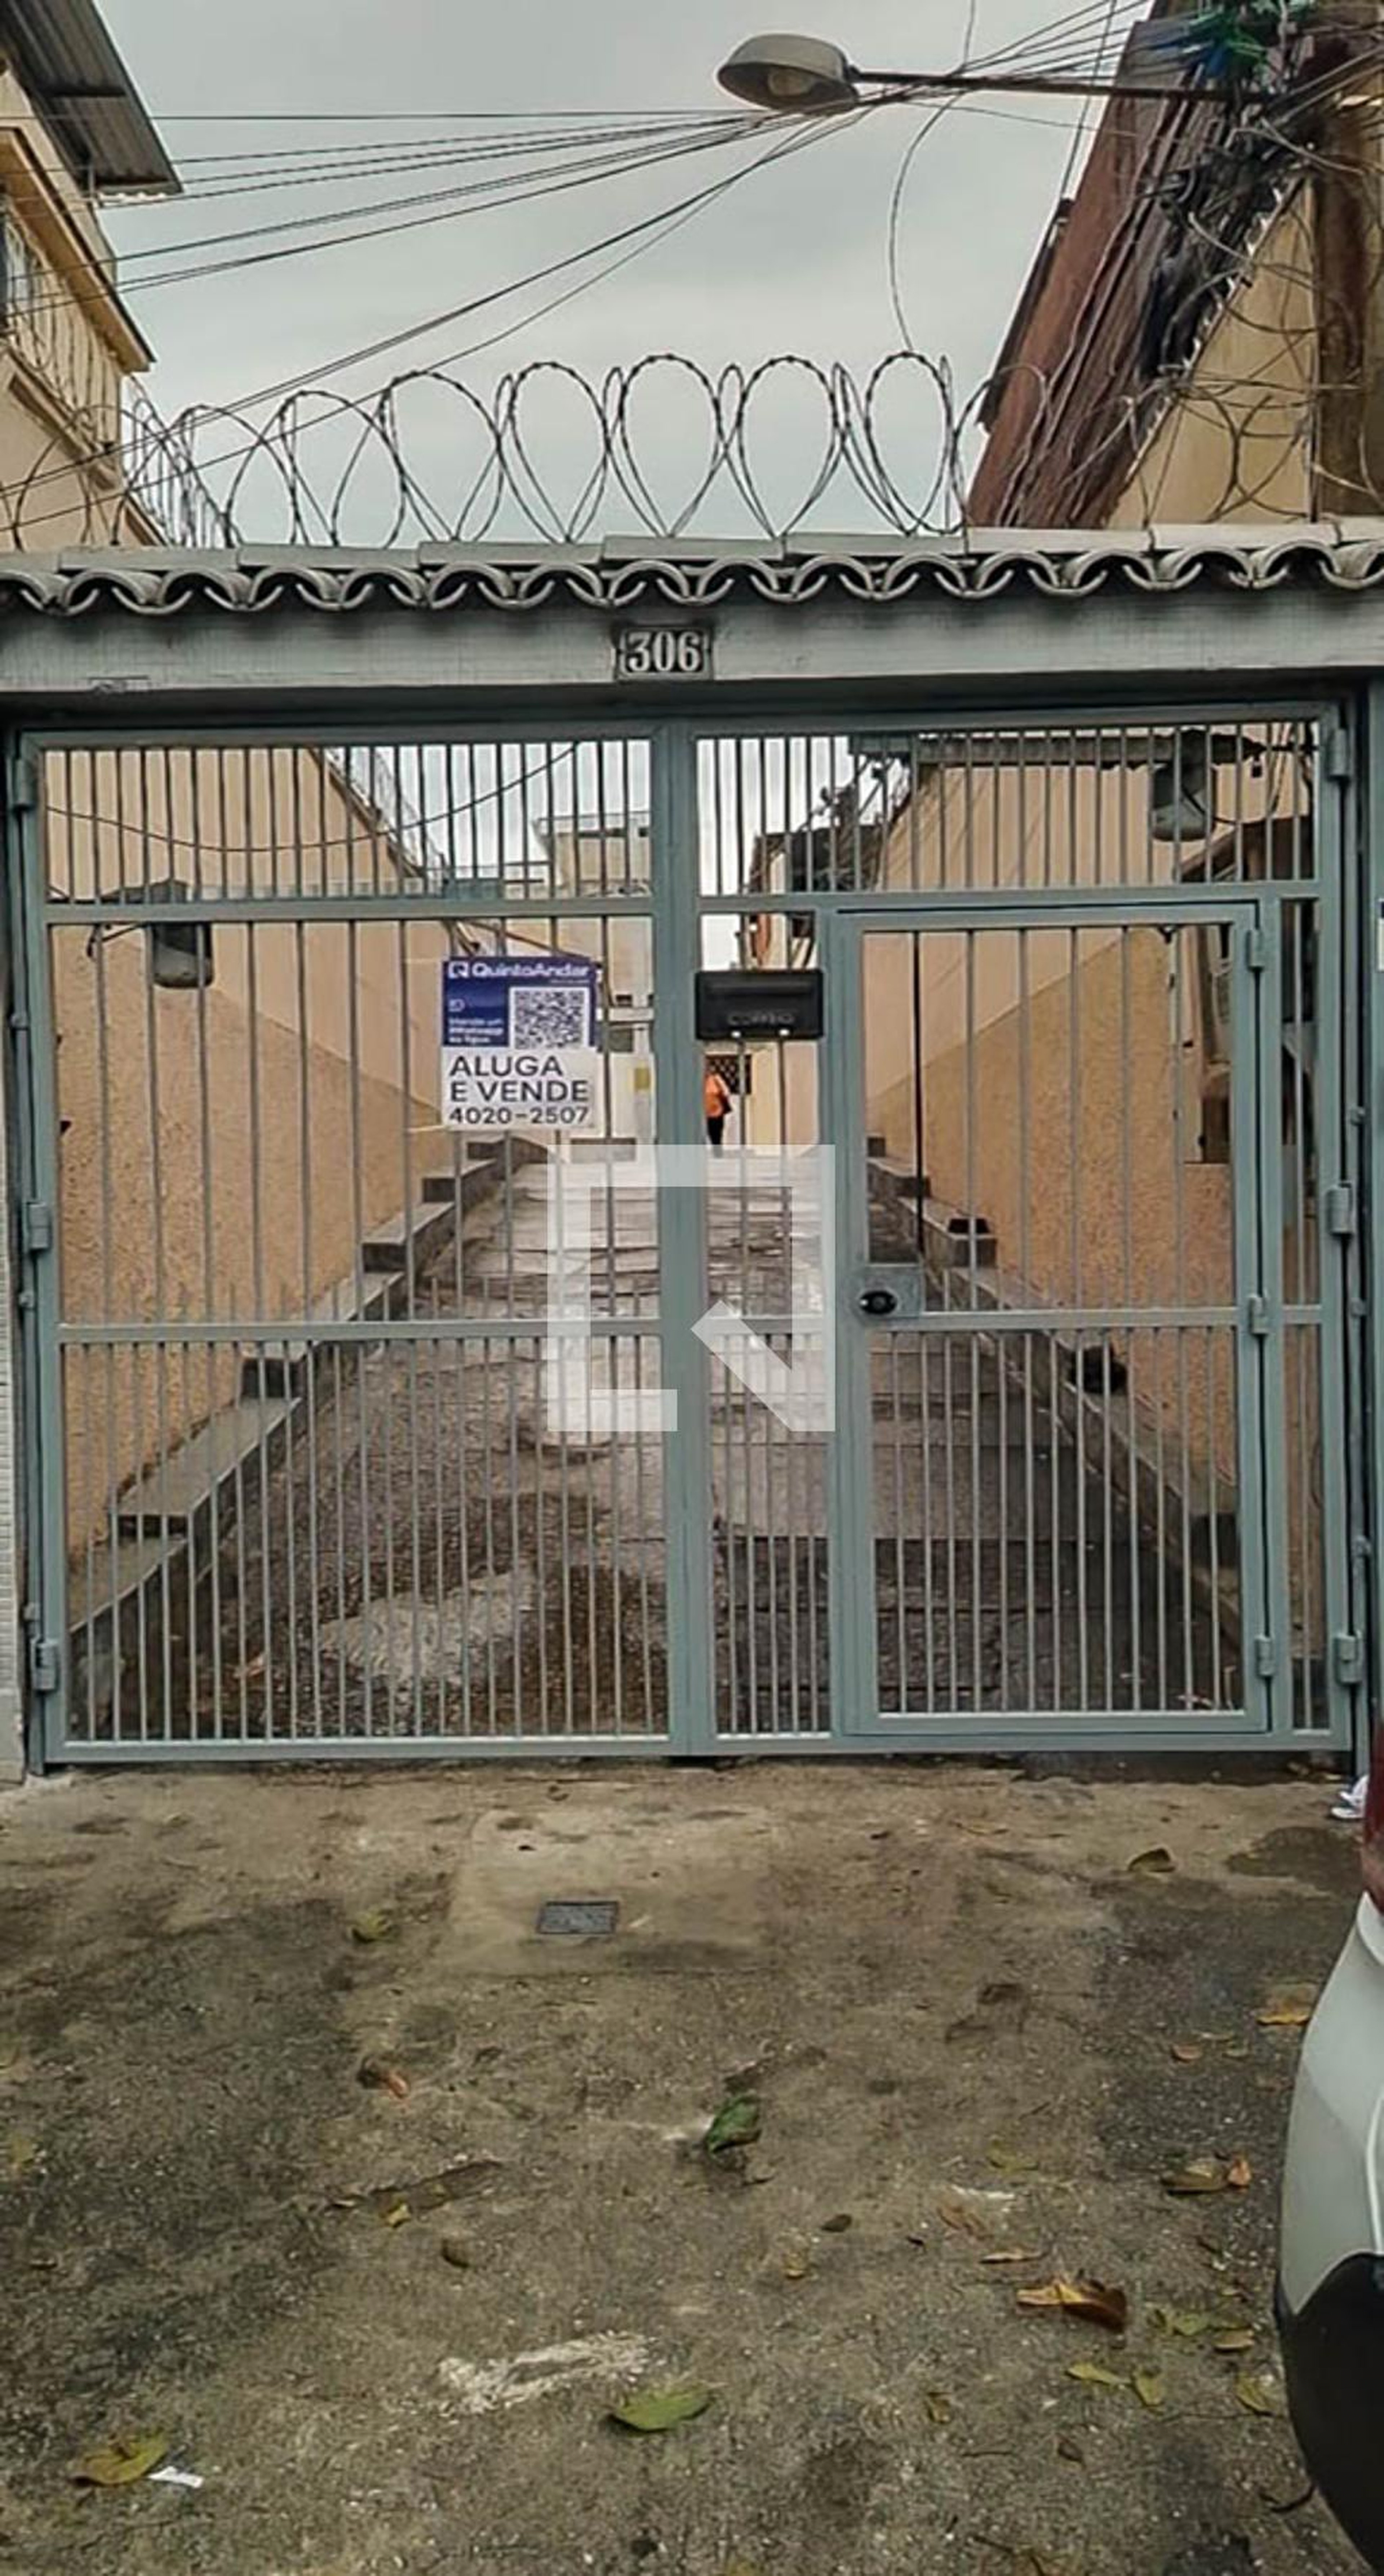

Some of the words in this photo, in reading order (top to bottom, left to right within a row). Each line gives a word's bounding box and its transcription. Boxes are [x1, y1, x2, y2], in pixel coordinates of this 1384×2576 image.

[628, 631, 701, 672] 306
[471, 962, 589, 977] QuintoAndar
[450, 1056, 563, 1076] ALUGA
[451, 1081, 466, 1102] E
[477, 1080, 589, 1102] VENDE
[450, 1106, 589, 1124] 4020-2507
